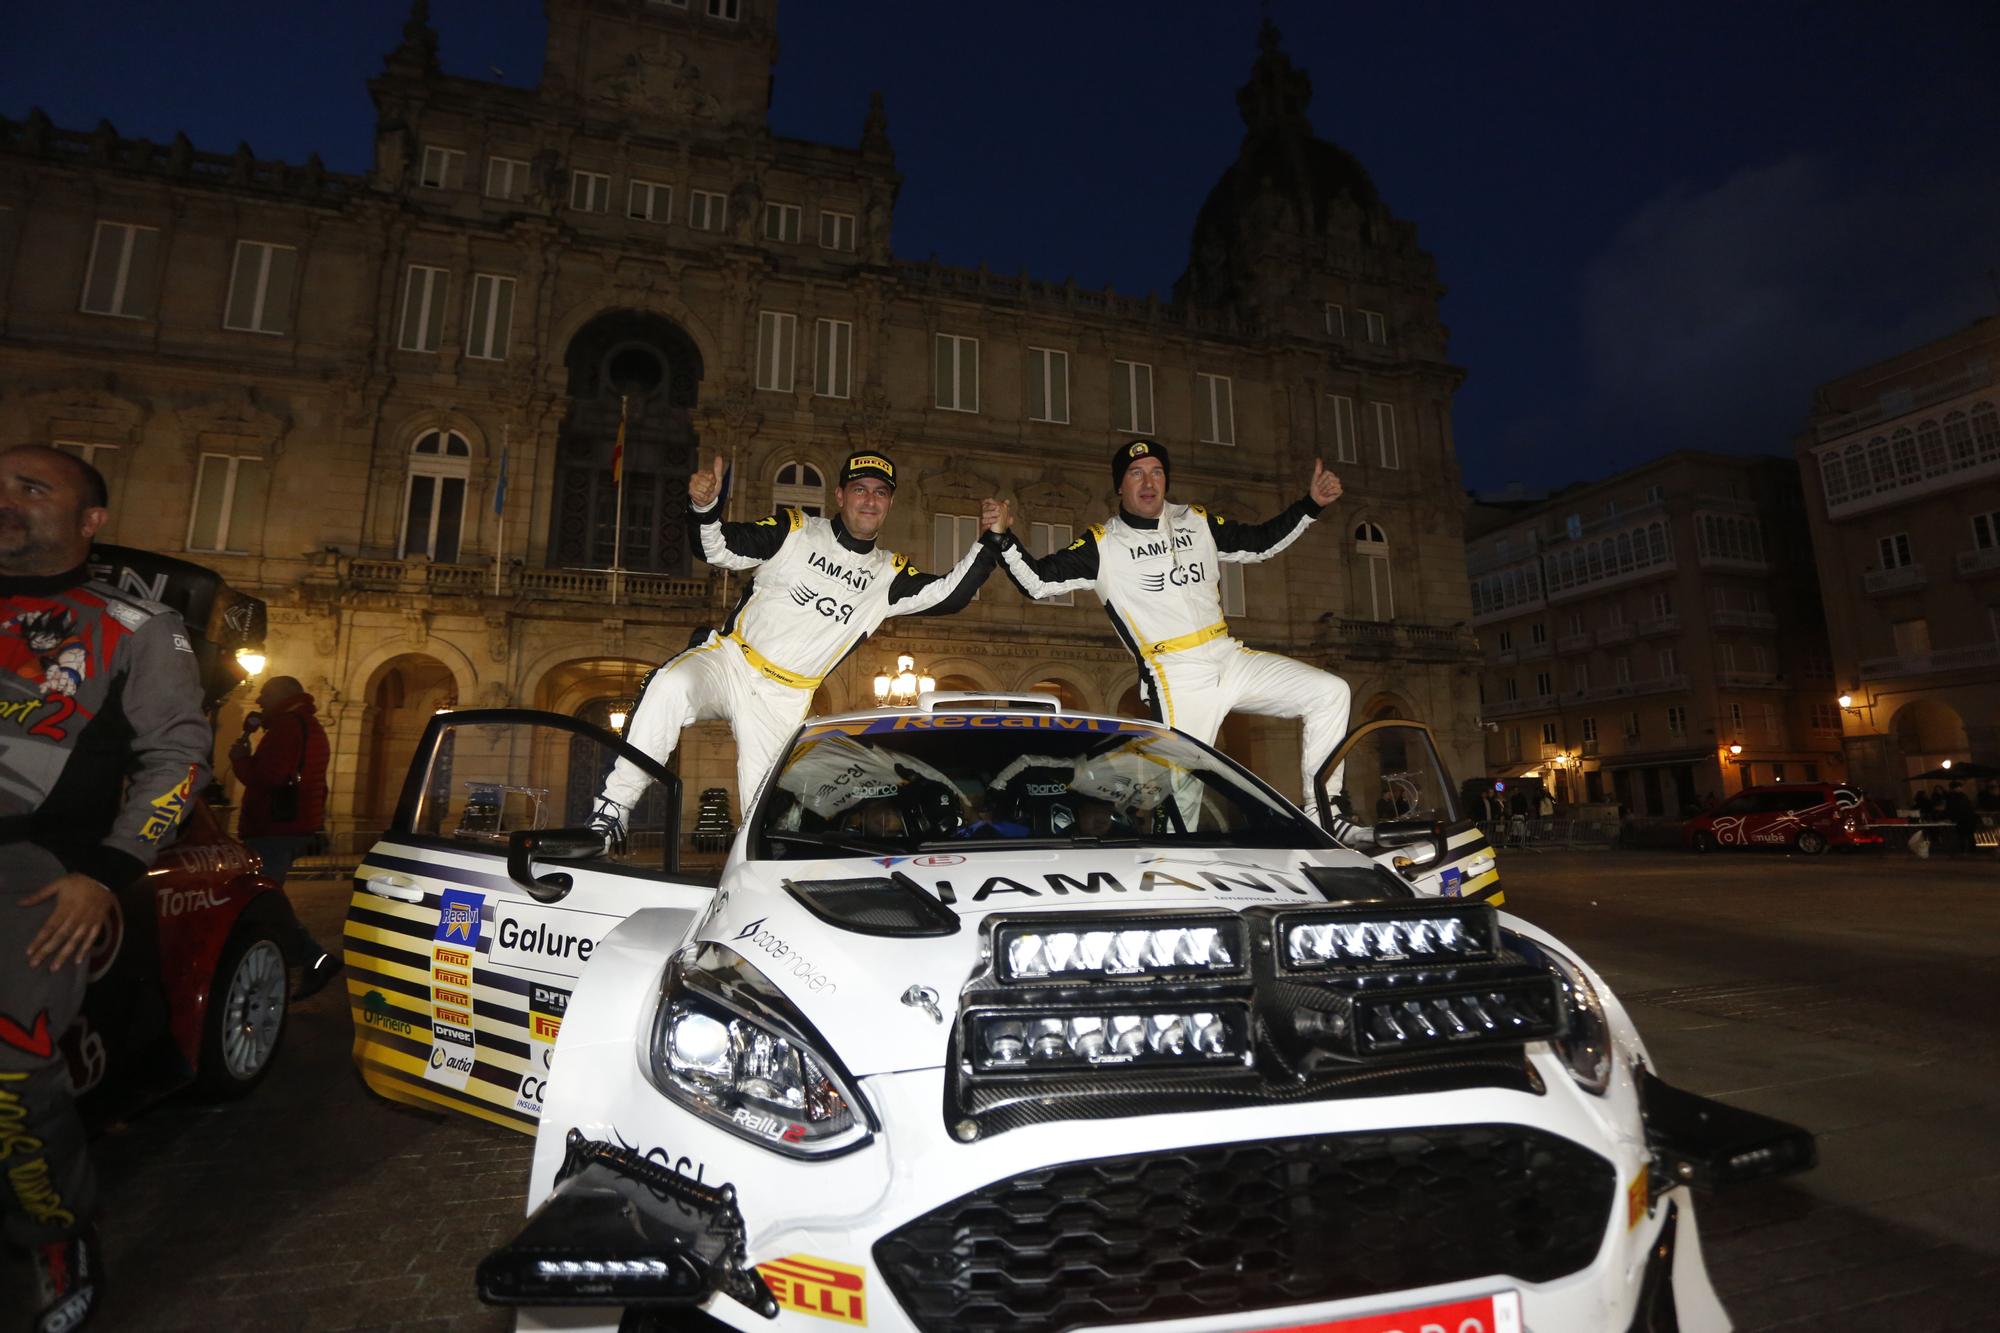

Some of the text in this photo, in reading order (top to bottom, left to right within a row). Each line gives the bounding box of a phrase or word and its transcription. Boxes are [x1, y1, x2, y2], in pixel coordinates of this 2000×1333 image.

[894, 714, 1100, 733] Recalvi
[935, 869, 1308, 905] IAMANI
[158, 886, 231, 918] TOTAL
[441, 907, 479, 924] Recalvi
[500, 918, 601, 962] Galure
[435, 948, 470, 967] PIRELLI
[435, 968, 468, 987] PIRELLI
[435, 988, 468, 1006] PIRELLI
[436, 1007, 469, 1026] PIRELLI
[446, 1056, 472, 1073] autia
